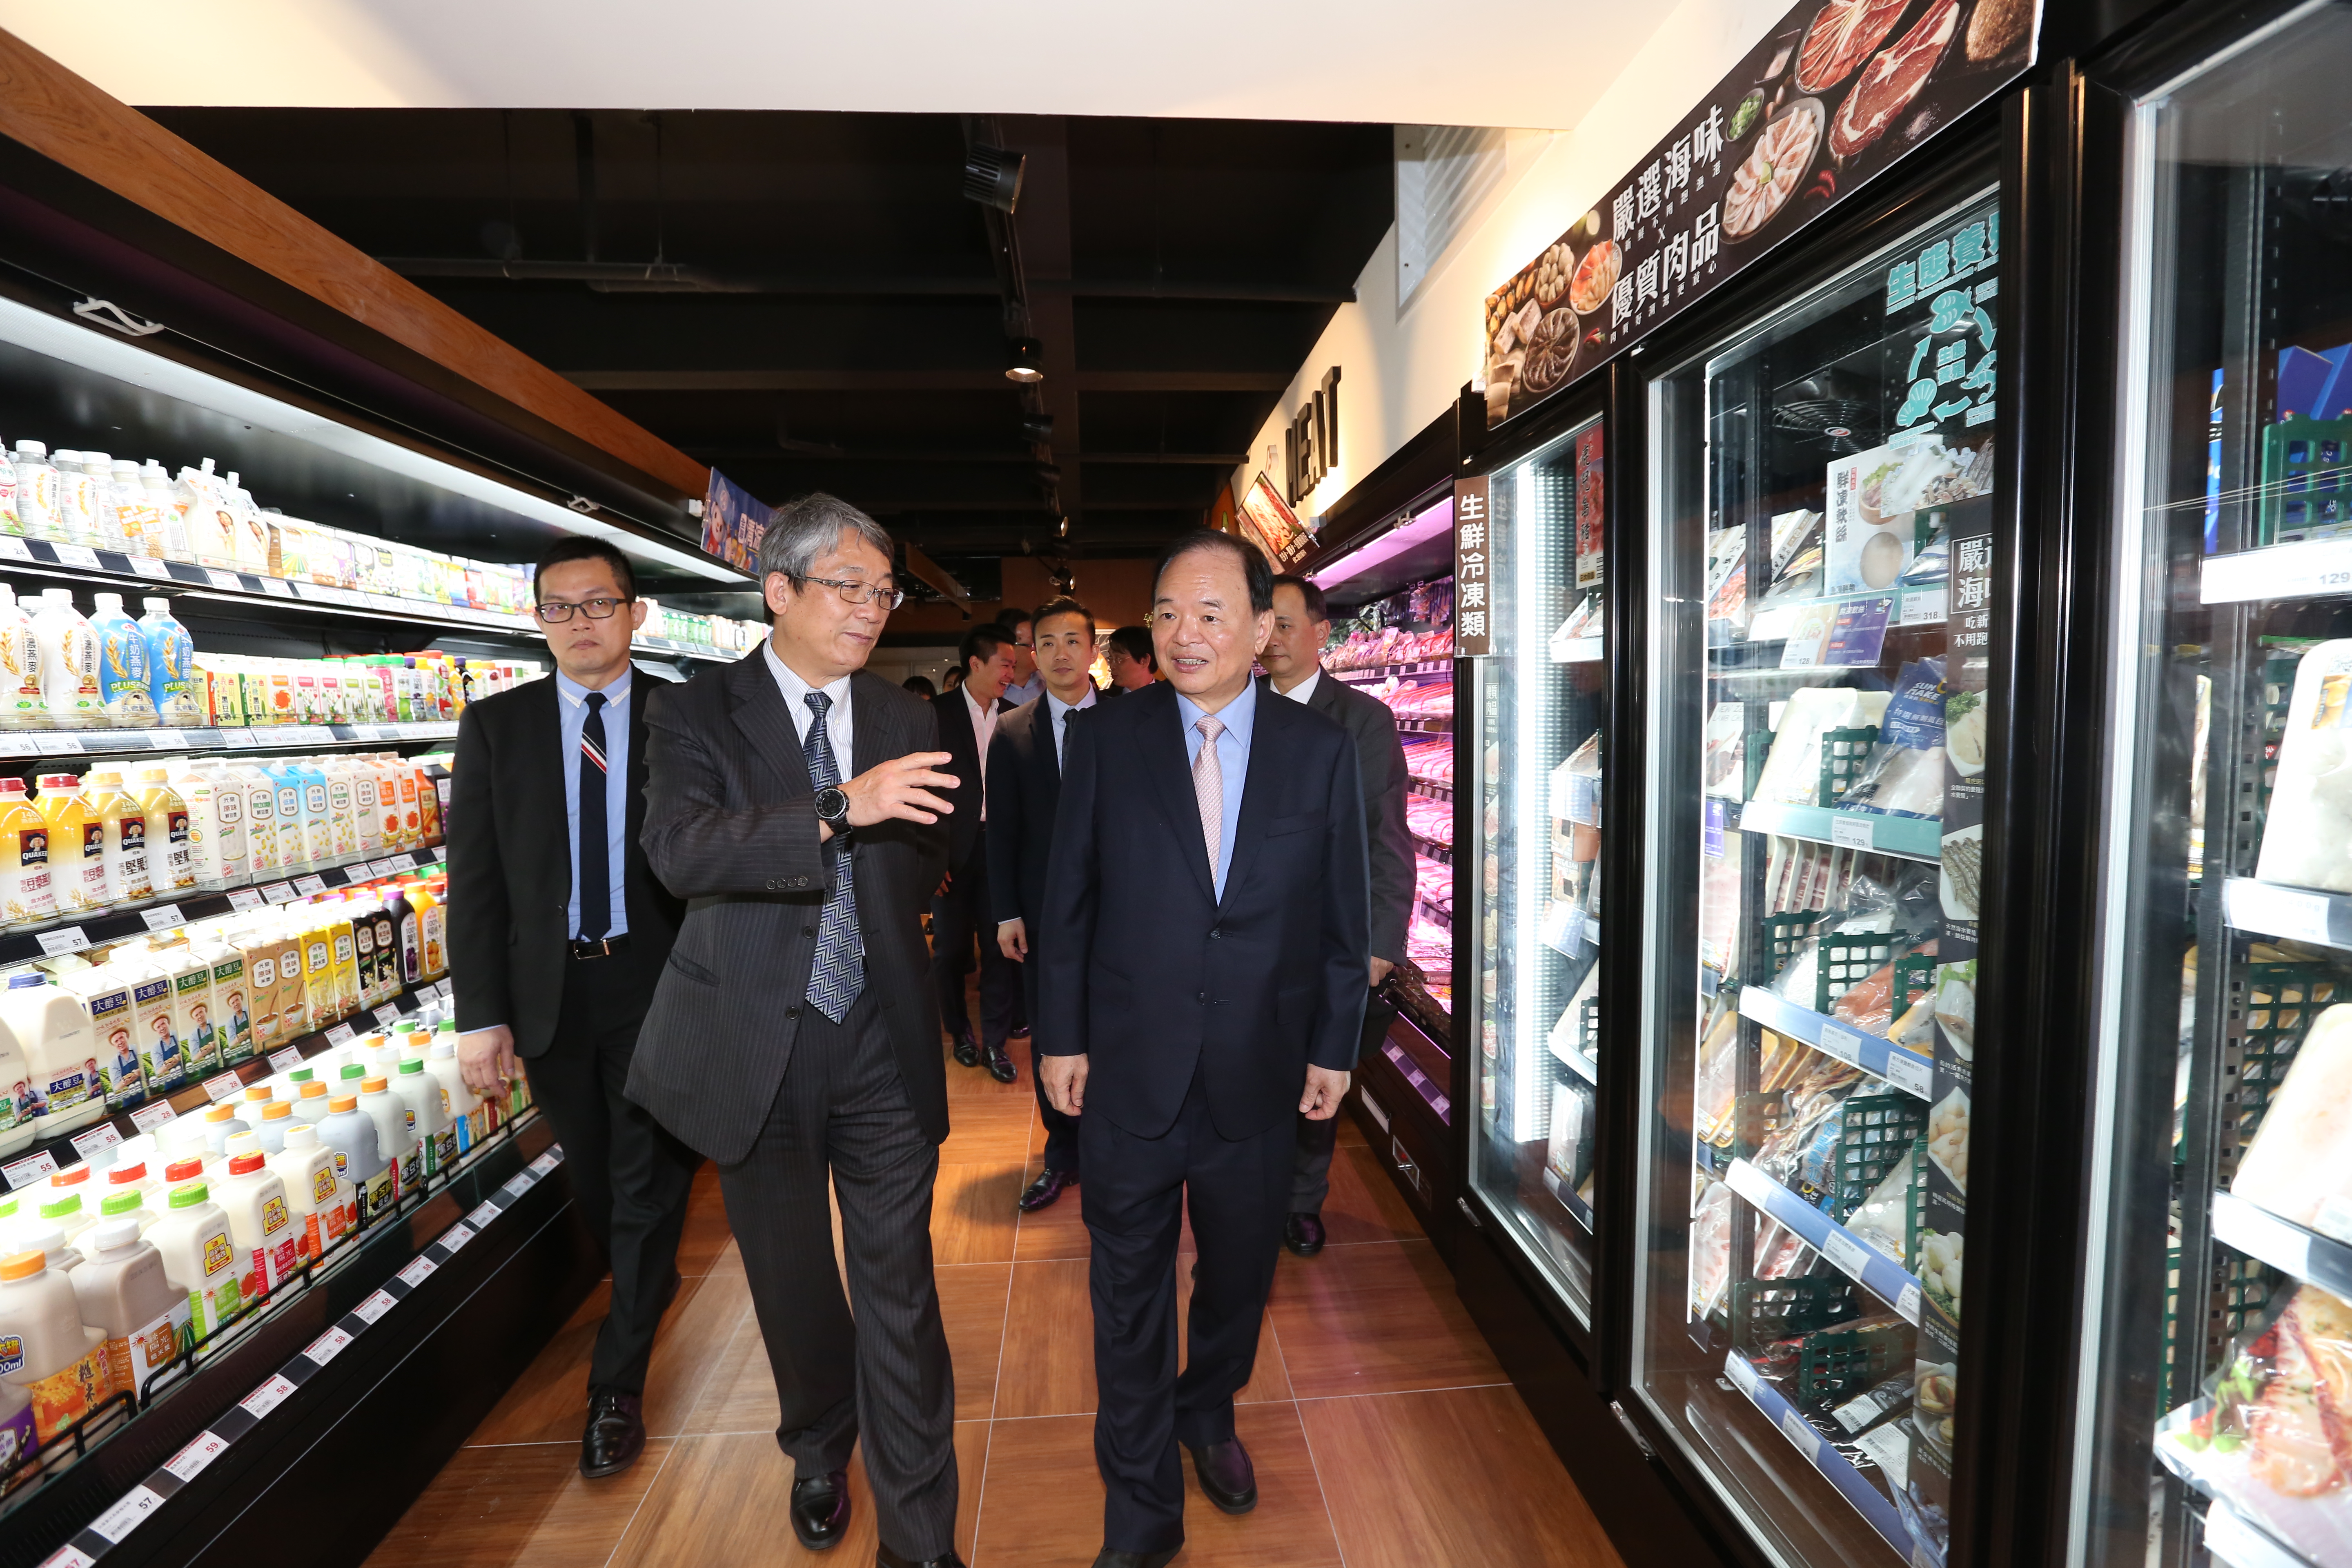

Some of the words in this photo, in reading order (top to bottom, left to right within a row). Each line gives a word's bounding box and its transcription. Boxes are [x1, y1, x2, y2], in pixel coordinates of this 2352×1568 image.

[1612, 104, 1724, 246] 嚴選海味
[1610, 201, 1719, 329] 優質肉品
[1286, 365, 1341, 508] MEAT
[1460, 494, 1486, 638] 生鮮冷凍類
[2319, 572, 2351, 584] 129
[1839, 605, 1865, 616] 鮮凍軟絲
[1923, 611, 1938, 620] 318
[1965, 614, 1988, 629] 吃新
[1953, 632, 1988, 647] 不用跑
[129, 633, 143, 679] 牛奶燕麥
[181, 637, 192, 679] 牛奶燕麥
[111, 681, 136, 692] PLUS
[165, 682, 185, 691] PLUS
[1912, 682, 1937, 691] SUN
[1905, 688, 1941, 701] MAKE
[1853, 837, 1865, 846] 129
[22, 851, 47, 860] QUAKER
[216, 962, 243, 976] 大醇豆
[285, 960, 297, 969] 原味
[179, 972, 207, 987] 大醇豆
[258, 970, 272, 978] 原味
[136, 983, 167, 999] 大醇豆
[94, 996, 127, 1012] 大醇豆
[52, 1076, 80, 1092] 大醇豆
[1914, 1083, 1924, 1093] 58
[105, 1134, 116, 1143] 55
[41, 1163, 52, 1172] 55
[381, 1297, 392, 1306] 58
[149, 1336, 169, 1352] 陽光
[334, 1335, 345, 1344] 58
[276, 1384, 288, 1394] 58
[206, 1441, 219, 1453] 59
[138, 1497, 153, 1510] 57
